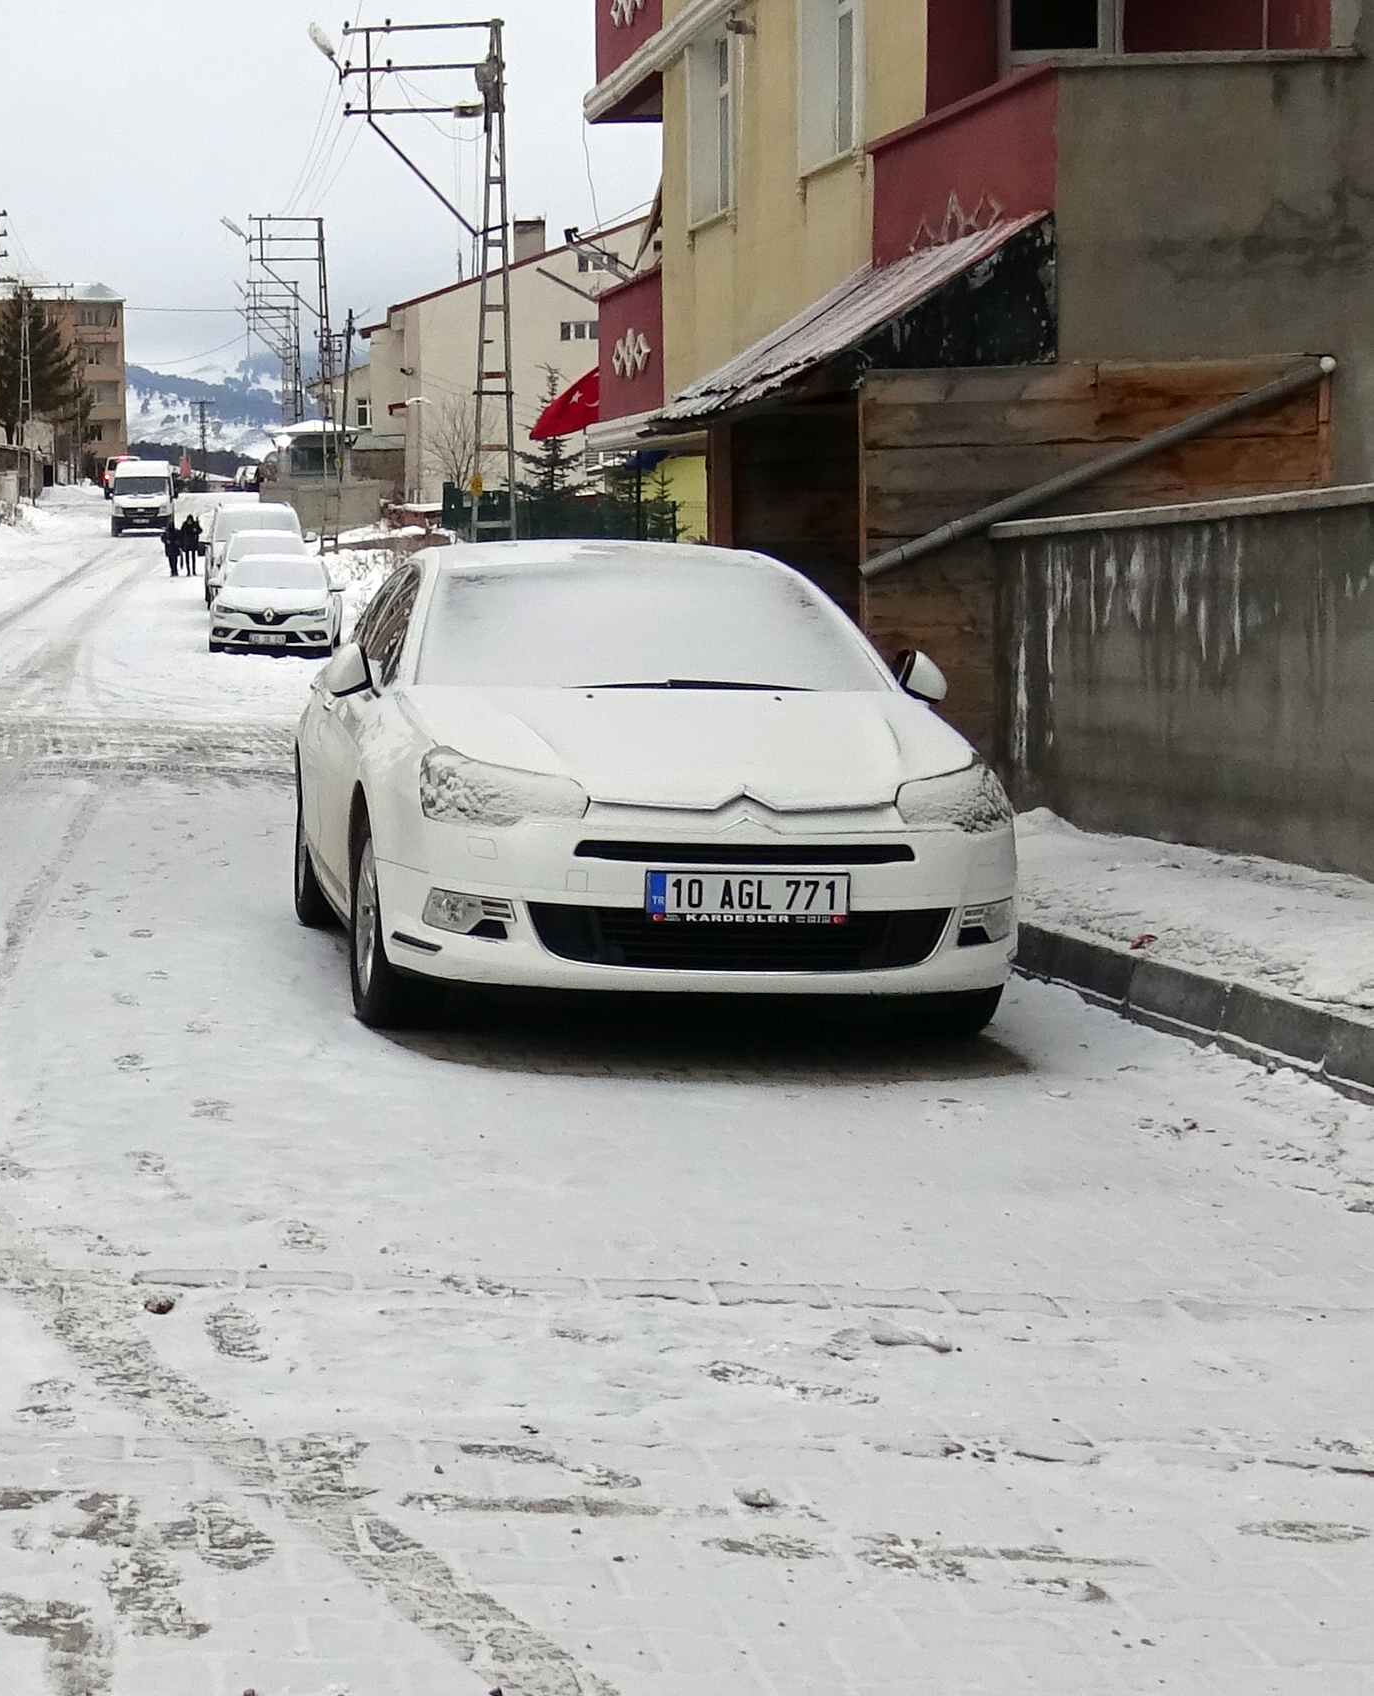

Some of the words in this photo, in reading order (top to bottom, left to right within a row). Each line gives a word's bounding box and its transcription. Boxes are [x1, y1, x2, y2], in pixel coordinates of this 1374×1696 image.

[652, 895, 665, 906] TR
[672, 878, 703, 908] 10
[720, 879, 771, 910] AGL
[786, 880, 836, 911] 771
